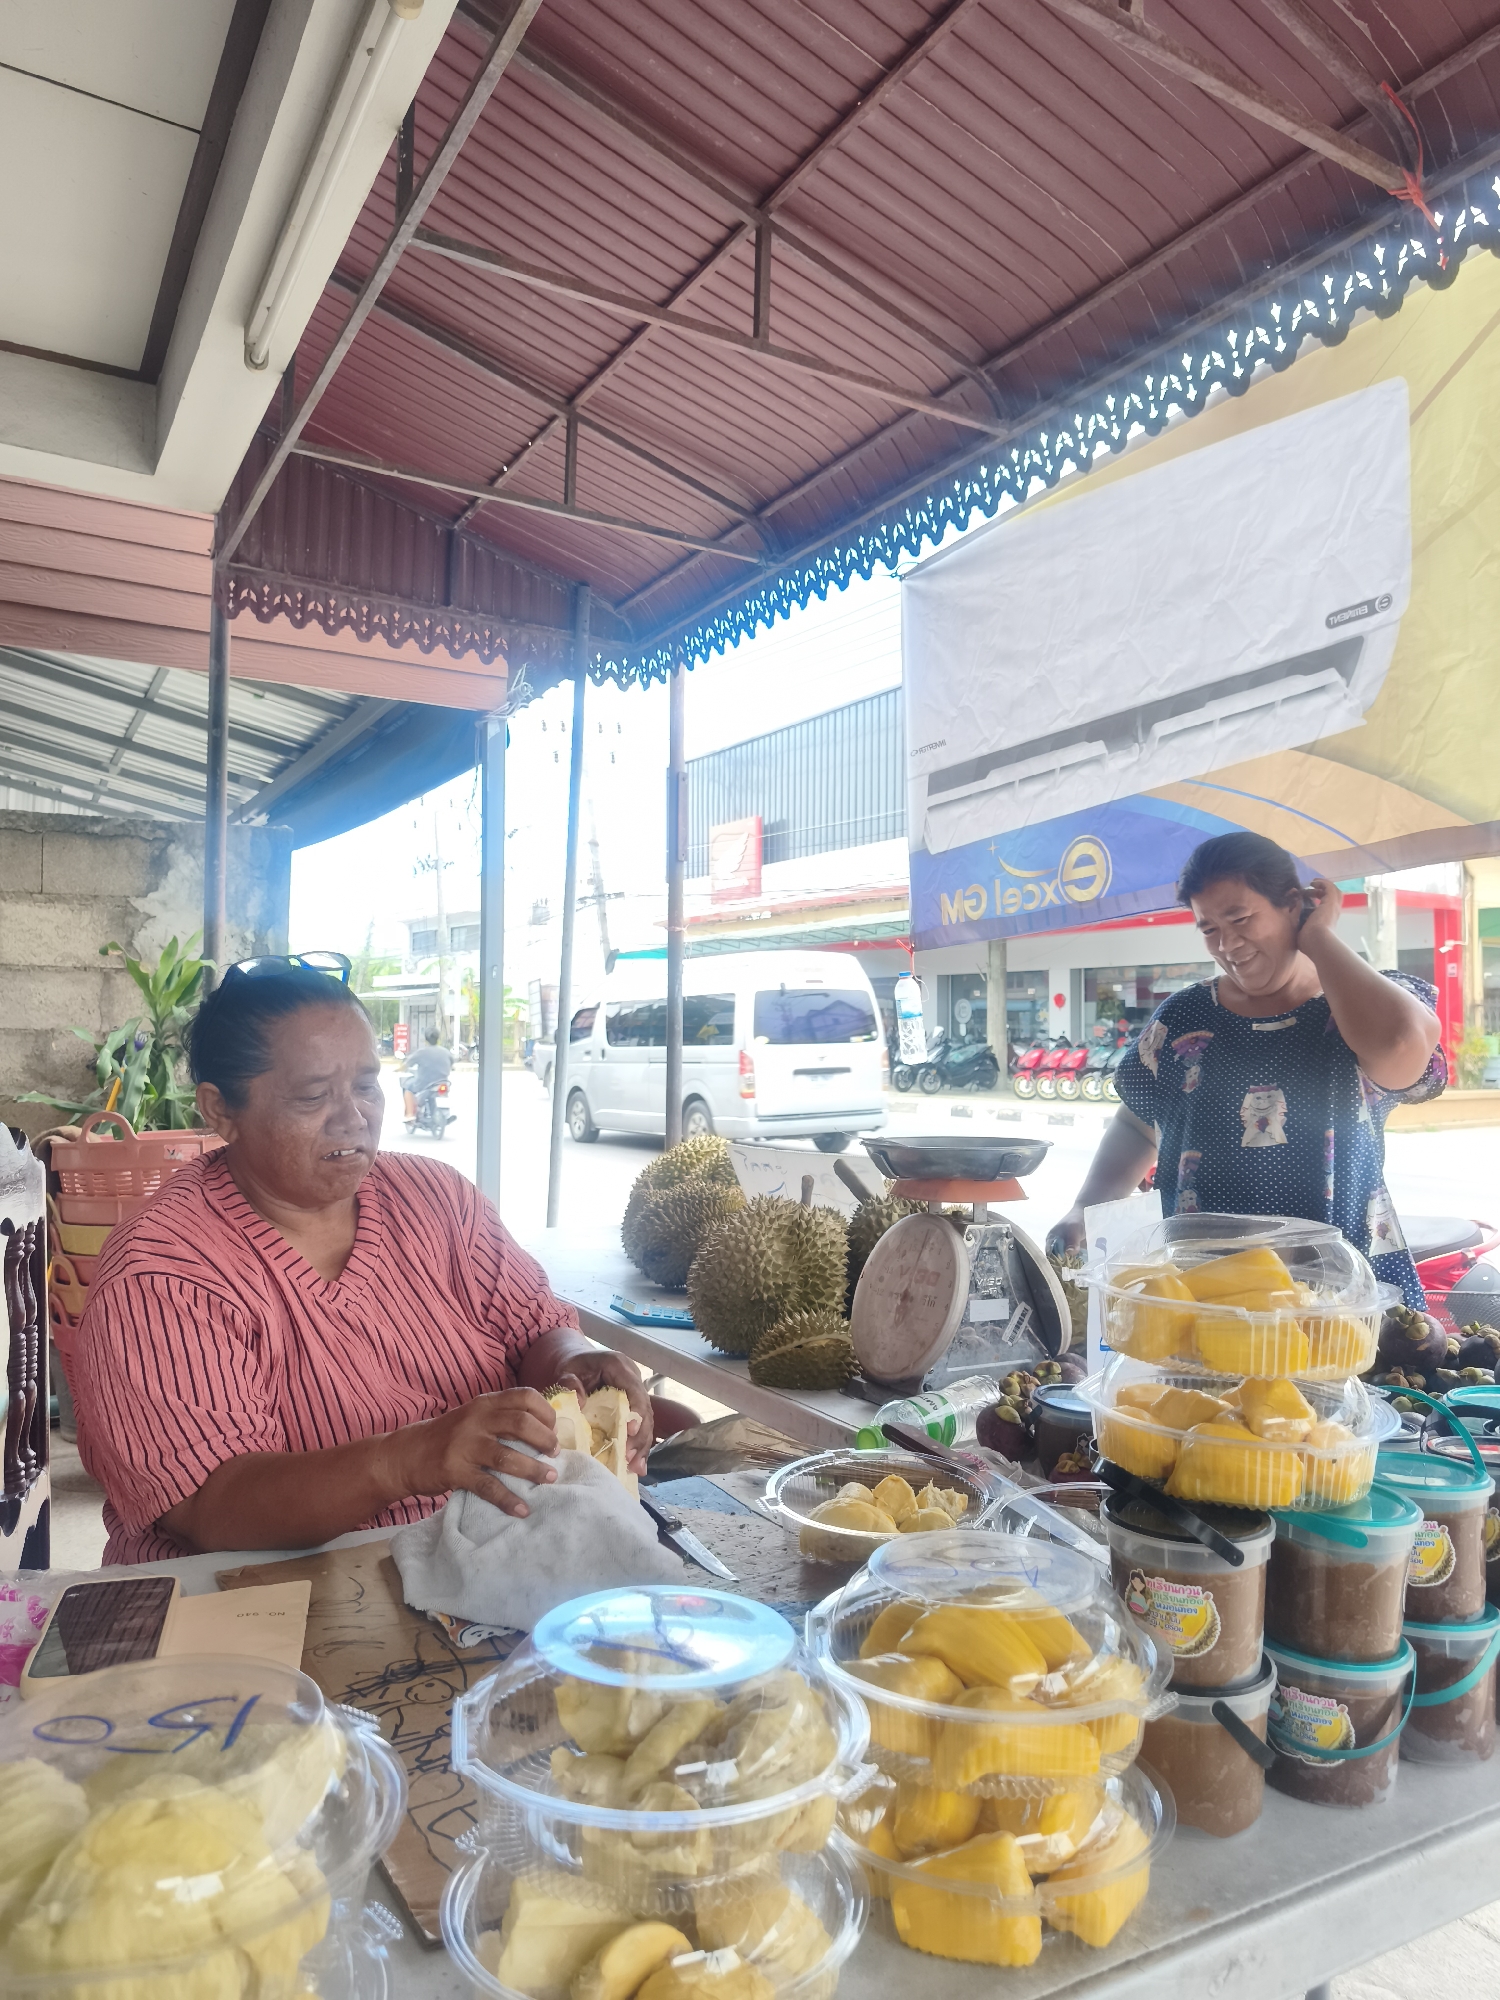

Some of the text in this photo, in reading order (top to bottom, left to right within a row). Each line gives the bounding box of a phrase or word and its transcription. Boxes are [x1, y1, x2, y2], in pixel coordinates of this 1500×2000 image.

[1146, 1578, 1201, 1596] ทุเรียนกวน
[1153, 1591, 1204, 1605] ทุเรียนทอด
[1155, 1602, 1198, 1614] หมอนทอง
[32, 1694, 263, 1755] 150
